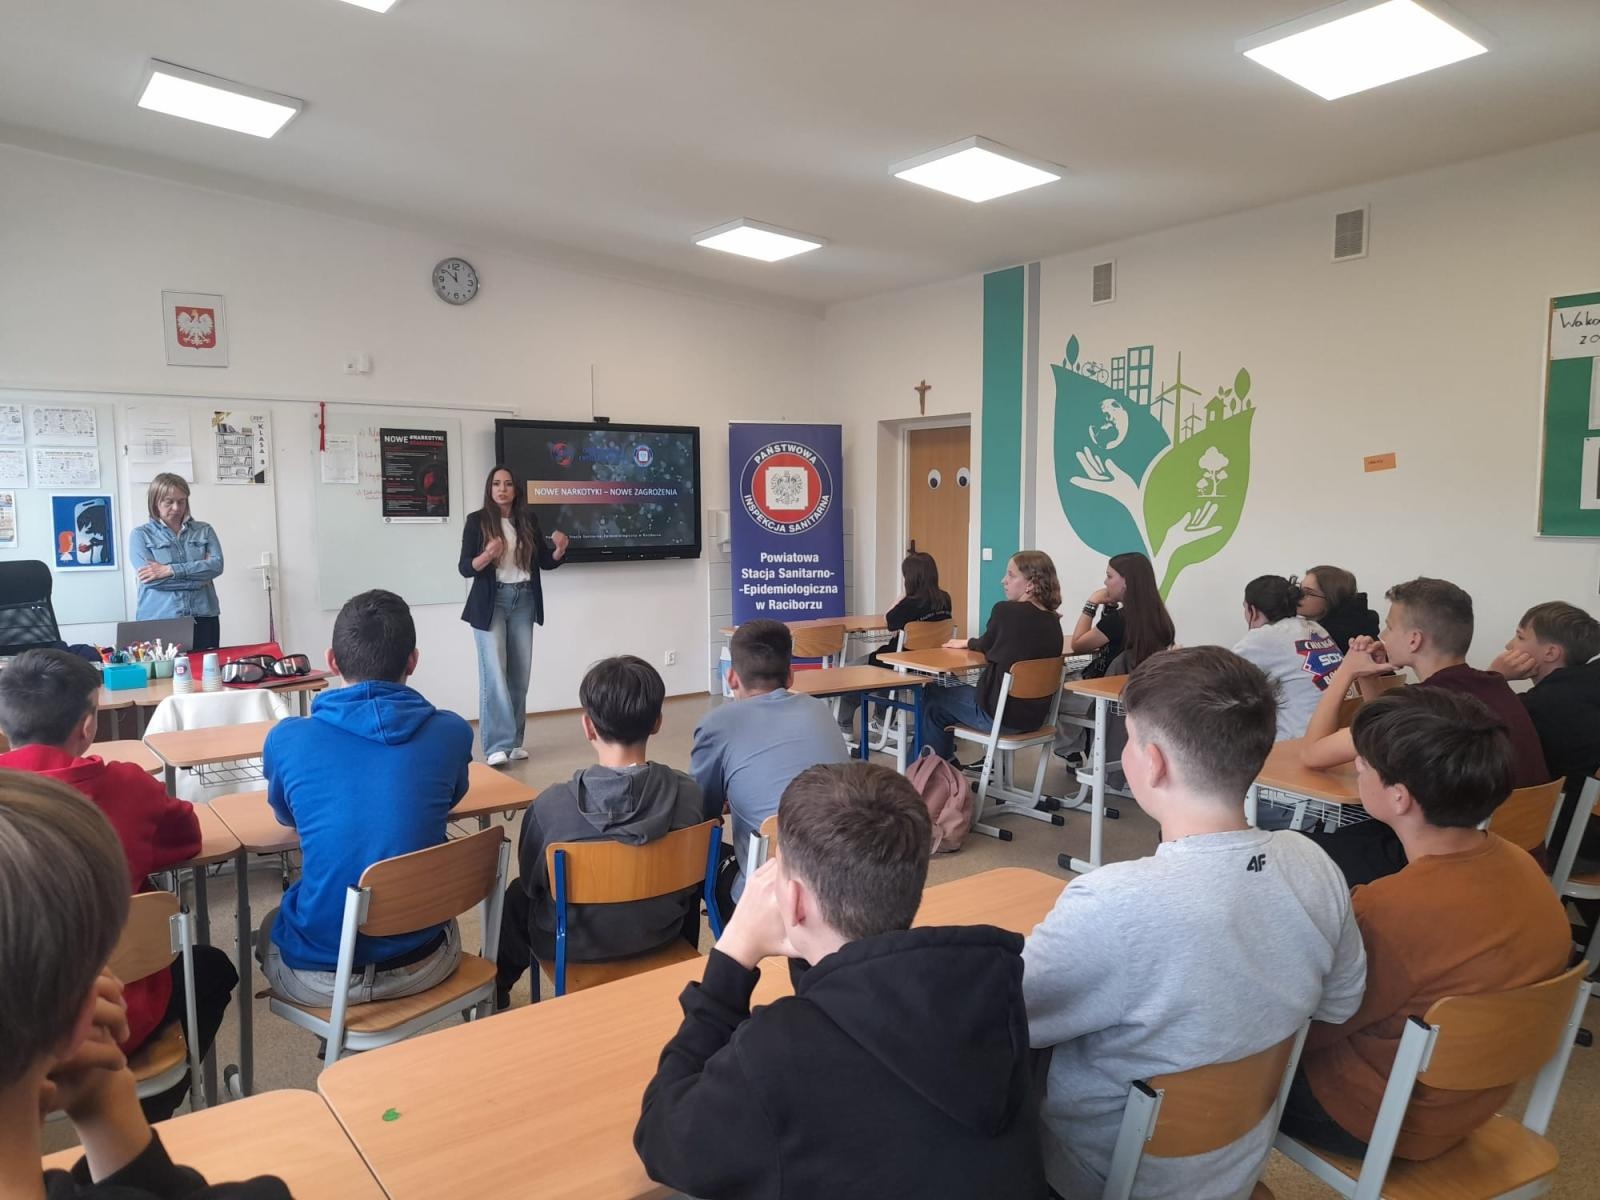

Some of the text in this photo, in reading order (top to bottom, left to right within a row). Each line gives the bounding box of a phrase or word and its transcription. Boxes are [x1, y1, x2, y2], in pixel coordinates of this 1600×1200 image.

[452, 263, 460, 271] 12
[384, 435, 409, 444] NOWE
[754, 443, 817, 465] PAŃSTWOWA
[534, 488, 559, 496] NOWE
[560, 488, 602, 496] NARKOTYKI
[609, 488, 633, 496] NOWE
[634, 487, 678, 496] ZAGROŻENIA
[744, 494, 830, 533] INSPEKCJA SANITARNA
[760, 552, 819, 563] Powiatowa
[741, 568, 835, 580] Stacja Sanitarno-
[739, 584, 838, 596] -Epidemiologiczna
[755, 599, 823, 610] w Raciborzu
